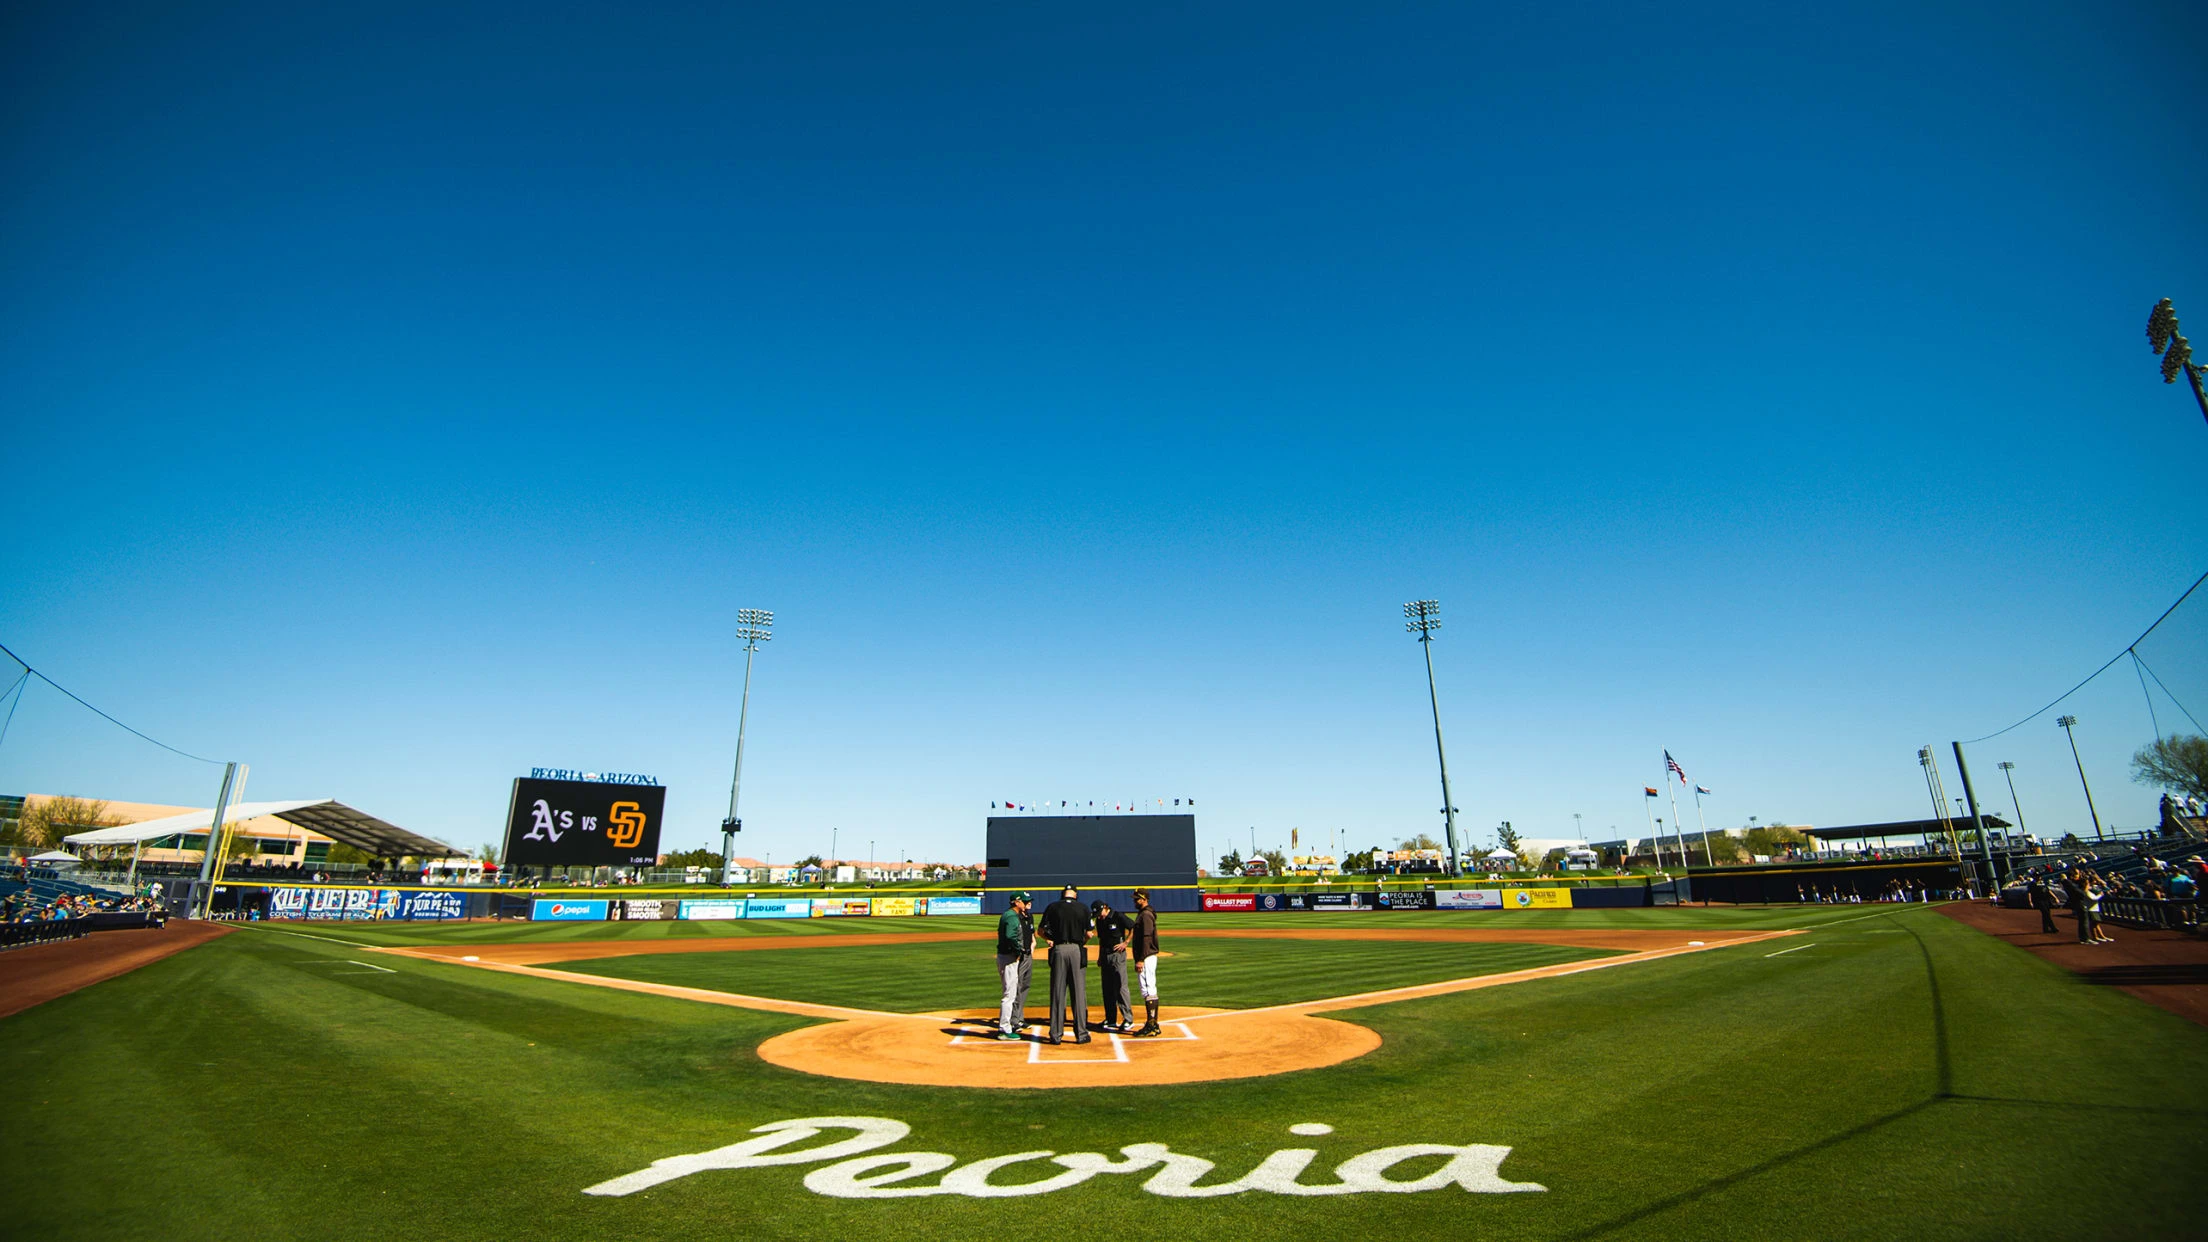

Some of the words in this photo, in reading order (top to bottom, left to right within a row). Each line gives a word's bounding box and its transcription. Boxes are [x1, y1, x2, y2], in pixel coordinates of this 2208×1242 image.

[531, 767, 584, 781] PEORIA
[598, 772, 658, 786] ARIZONA
[606, 801, 647, 848] SD
[271, 887, 310, 911] KILT
[402, 899, 430, 916] FOUR
[564, 905, 590, 914] pepsi
[582, 1116, 1548, 1198] Peoria
